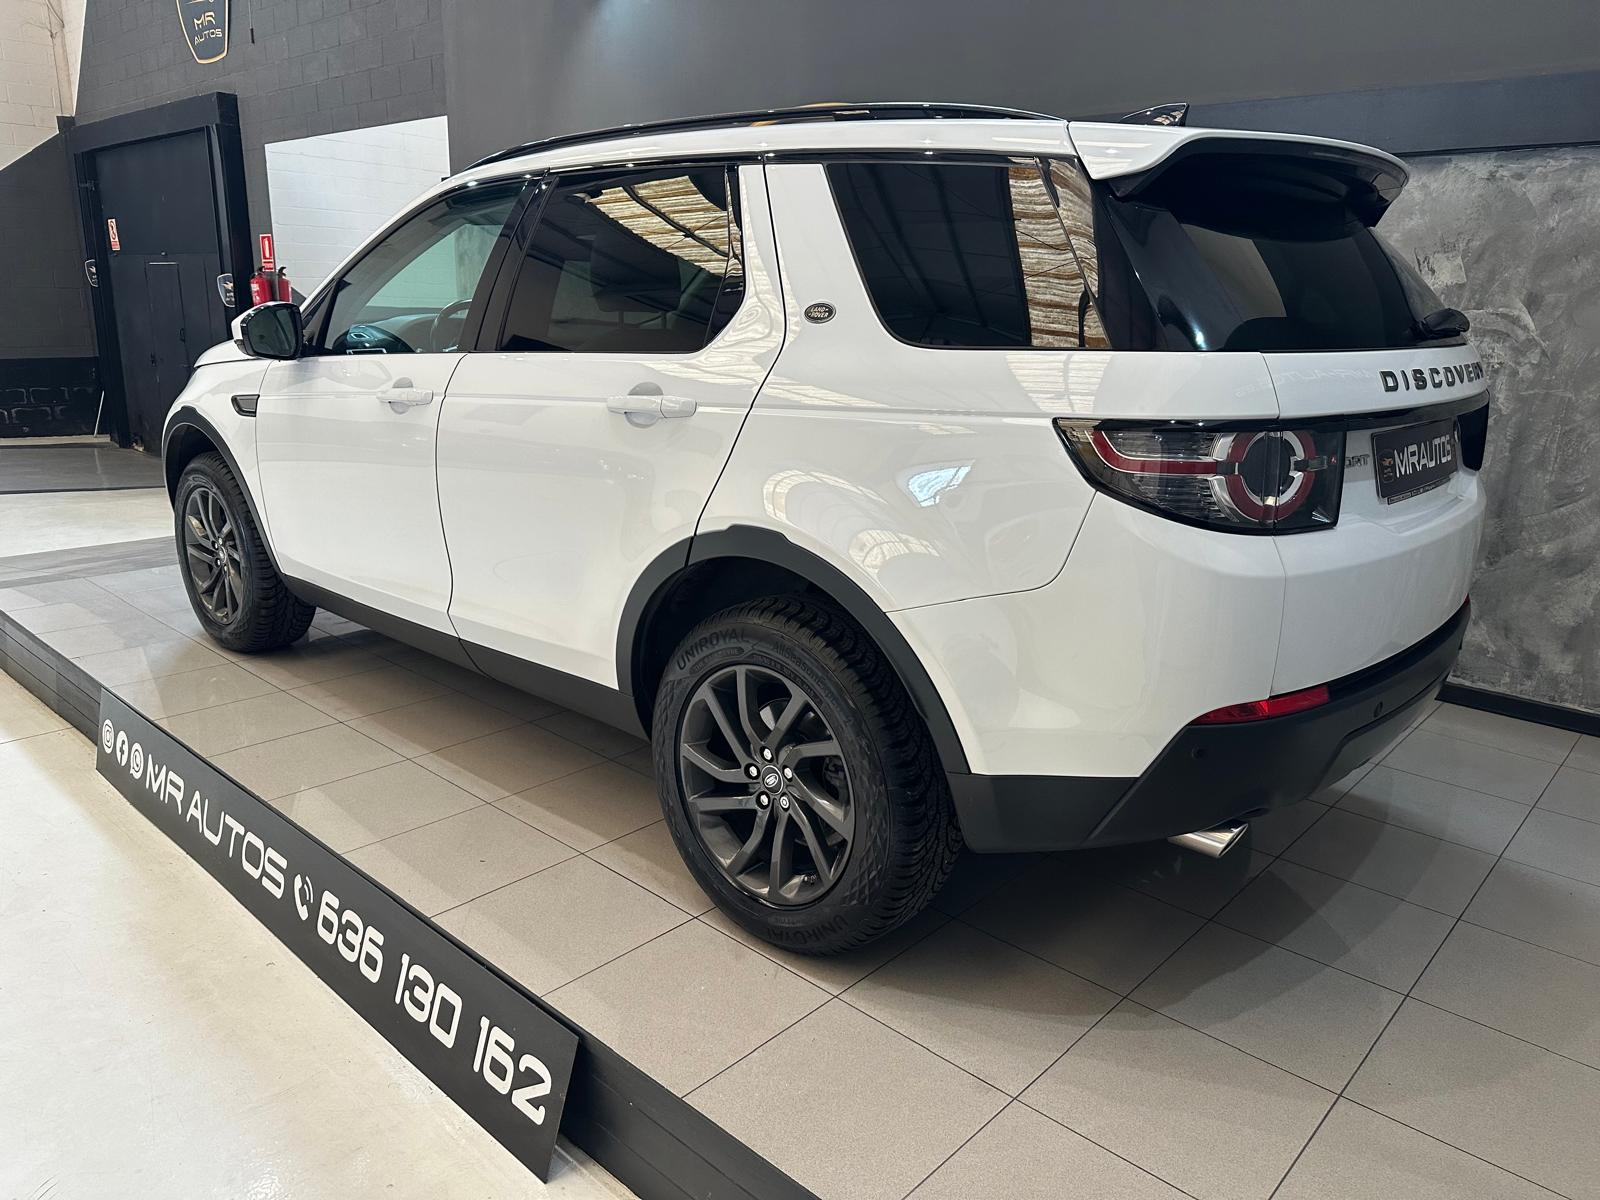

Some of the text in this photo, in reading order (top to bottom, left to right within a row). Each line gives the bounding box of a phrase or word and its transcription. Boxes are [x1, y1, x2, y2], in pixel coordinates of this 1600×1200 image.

[193, 11, 216, 31] MR
[194, 28, 223, 46] AUTOS
[676, 628, 751, 671] UNIROYAL
[146, 753, 552, 1126] MR AUTOS 636 130 162
